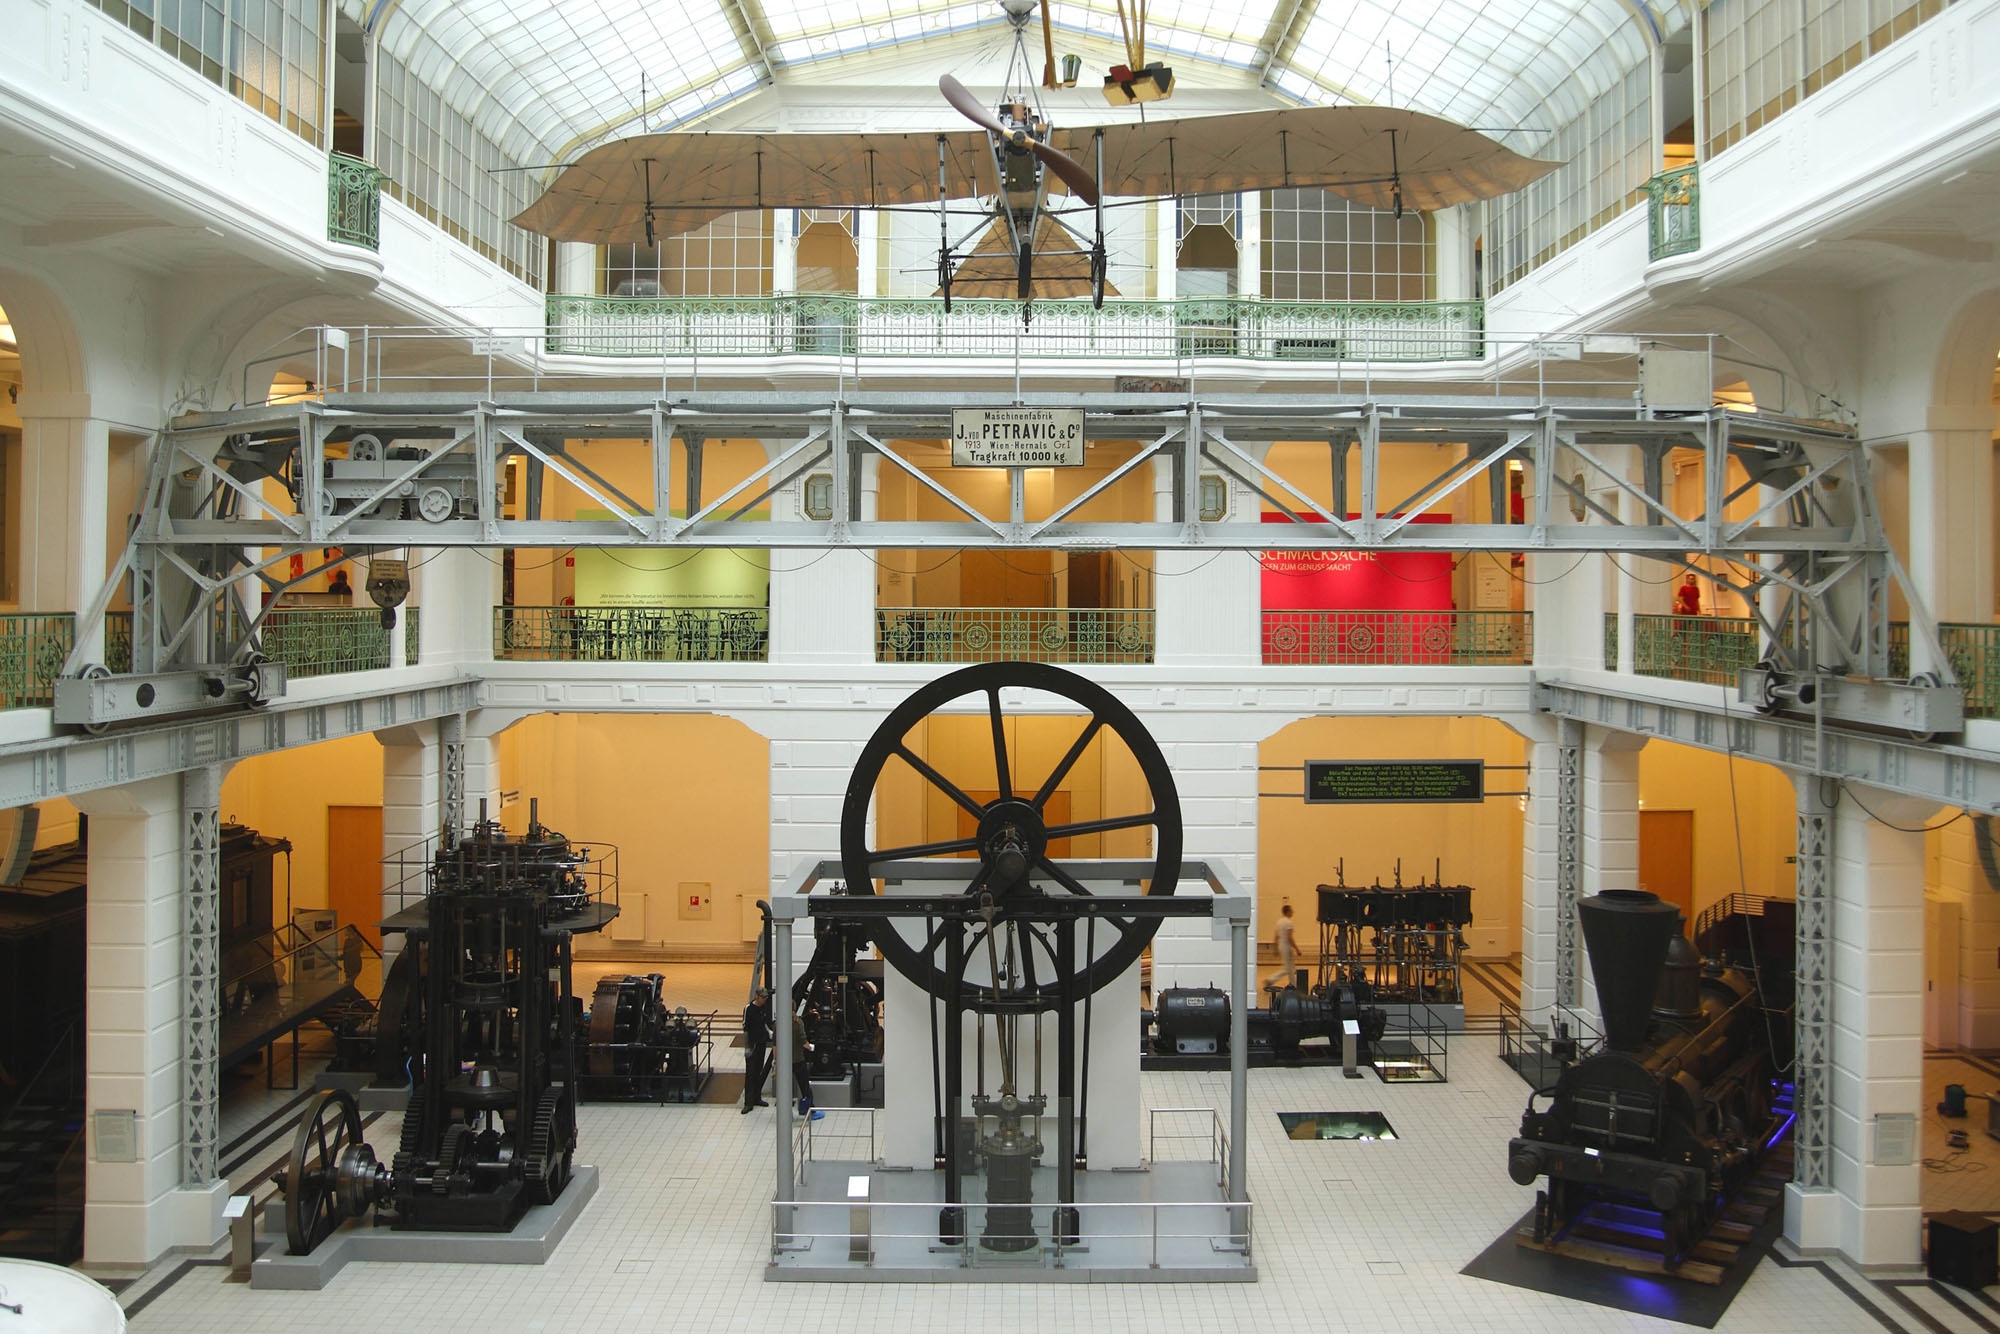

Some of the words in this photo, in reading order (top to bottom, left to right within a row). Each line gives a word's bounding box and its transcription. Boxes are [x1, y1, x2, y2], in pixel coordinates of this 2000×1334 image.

[984, 410, 1053, 420] Maschinenfabrik
[956, 424, 968, 440] J.
[1059, 429, 1066, 440] &
[964, 440, 981, 450] 1913
[990, 441, 1047, 450] Wien-Hernals
[970, 450, 1016, 464] Tragkraft
[1019, 451, 1051, 462] 10.000
